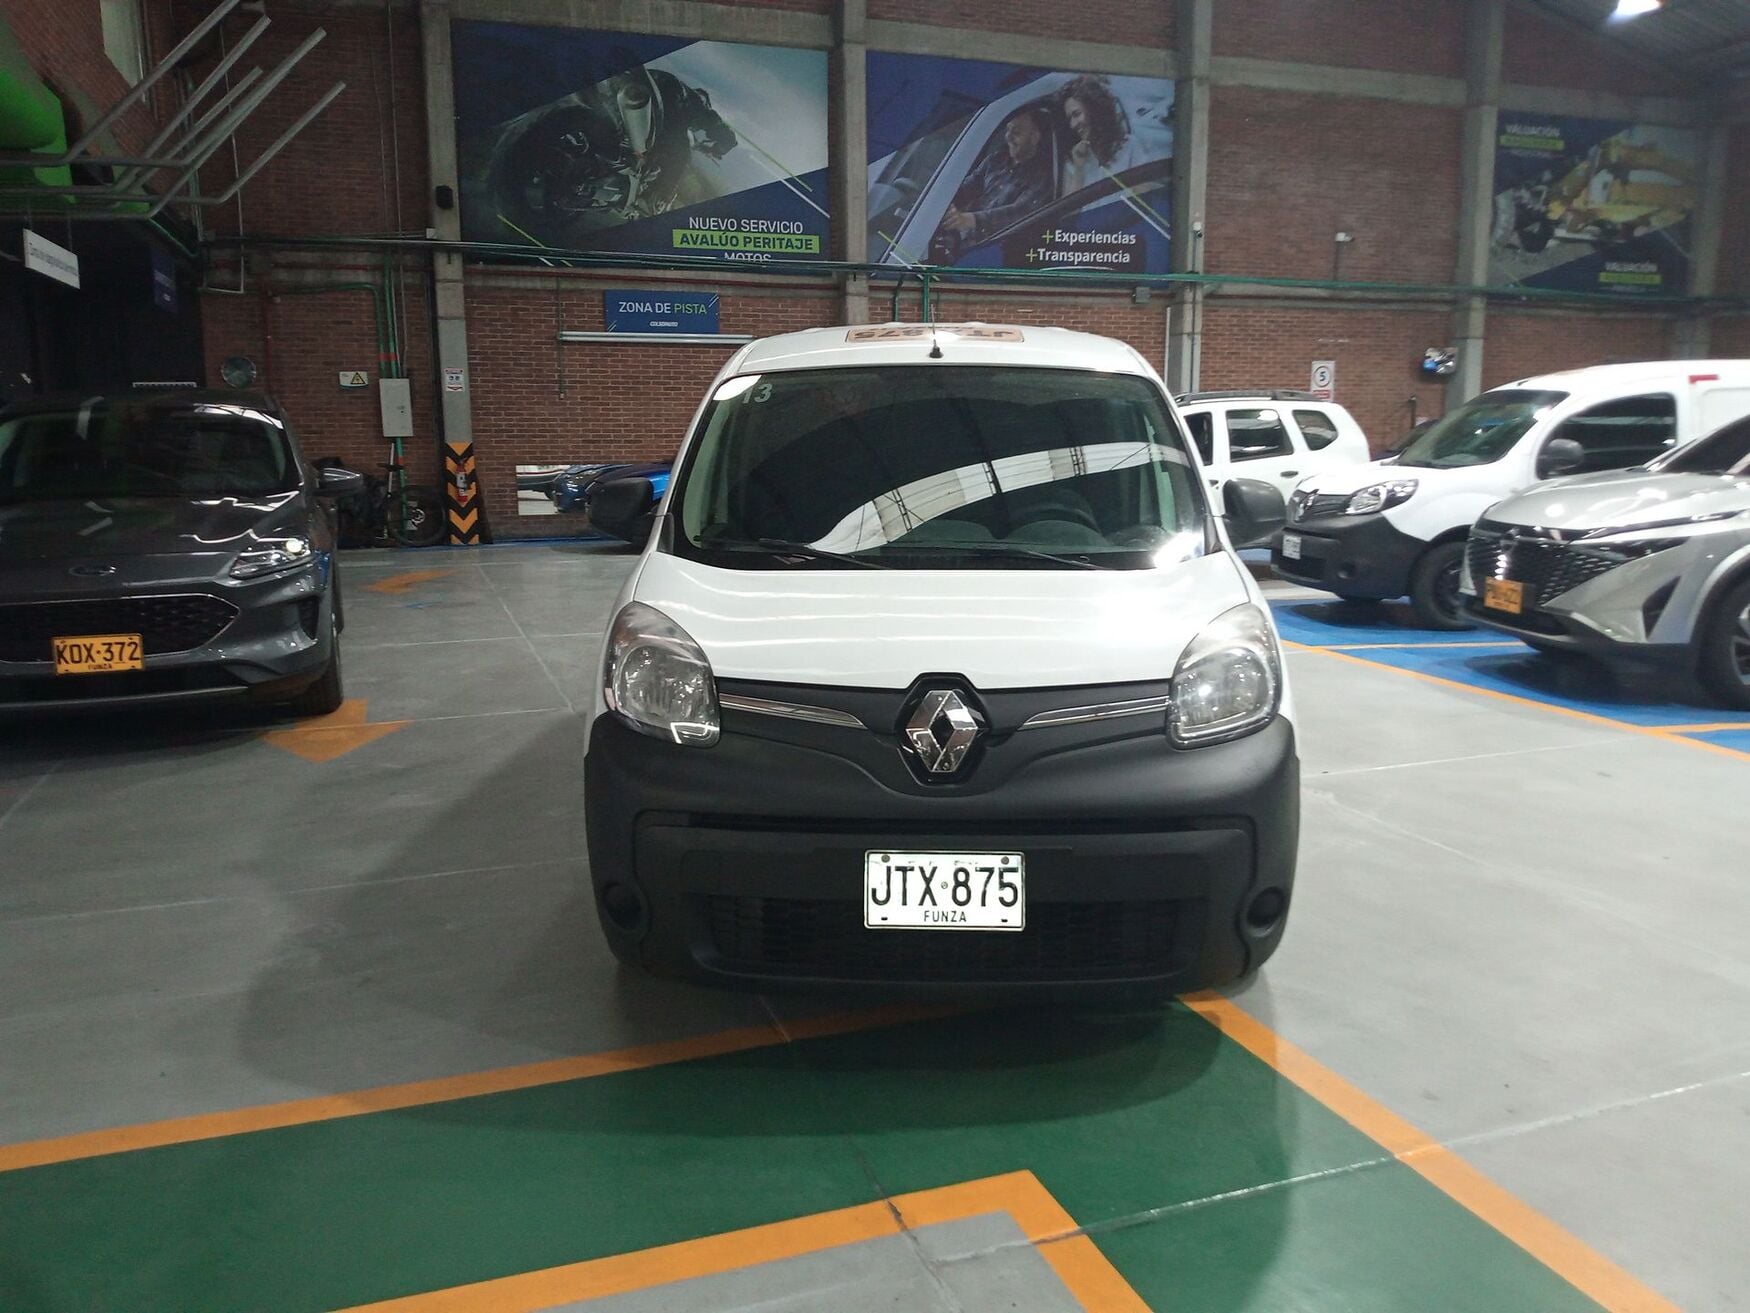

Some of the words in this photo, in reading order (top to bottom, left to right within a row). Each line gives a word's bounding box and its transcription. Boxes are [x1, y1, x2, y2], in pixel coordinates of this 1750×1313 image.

[689, 216, 737, 231] NUEVO
[740, 219, 803, 234] SERVICIO
[679, 232, 739, 247] AVALÚO
[743, 236, 813, 250] PERITAJE
[619, 302, 653, 313] ZONA
[655, 302, 672, 314] DE
[674, 303, 708, 315] PISTA
[1319, 371, 1327, 382] 5
[923, 910, 967, 923] FUNZA
